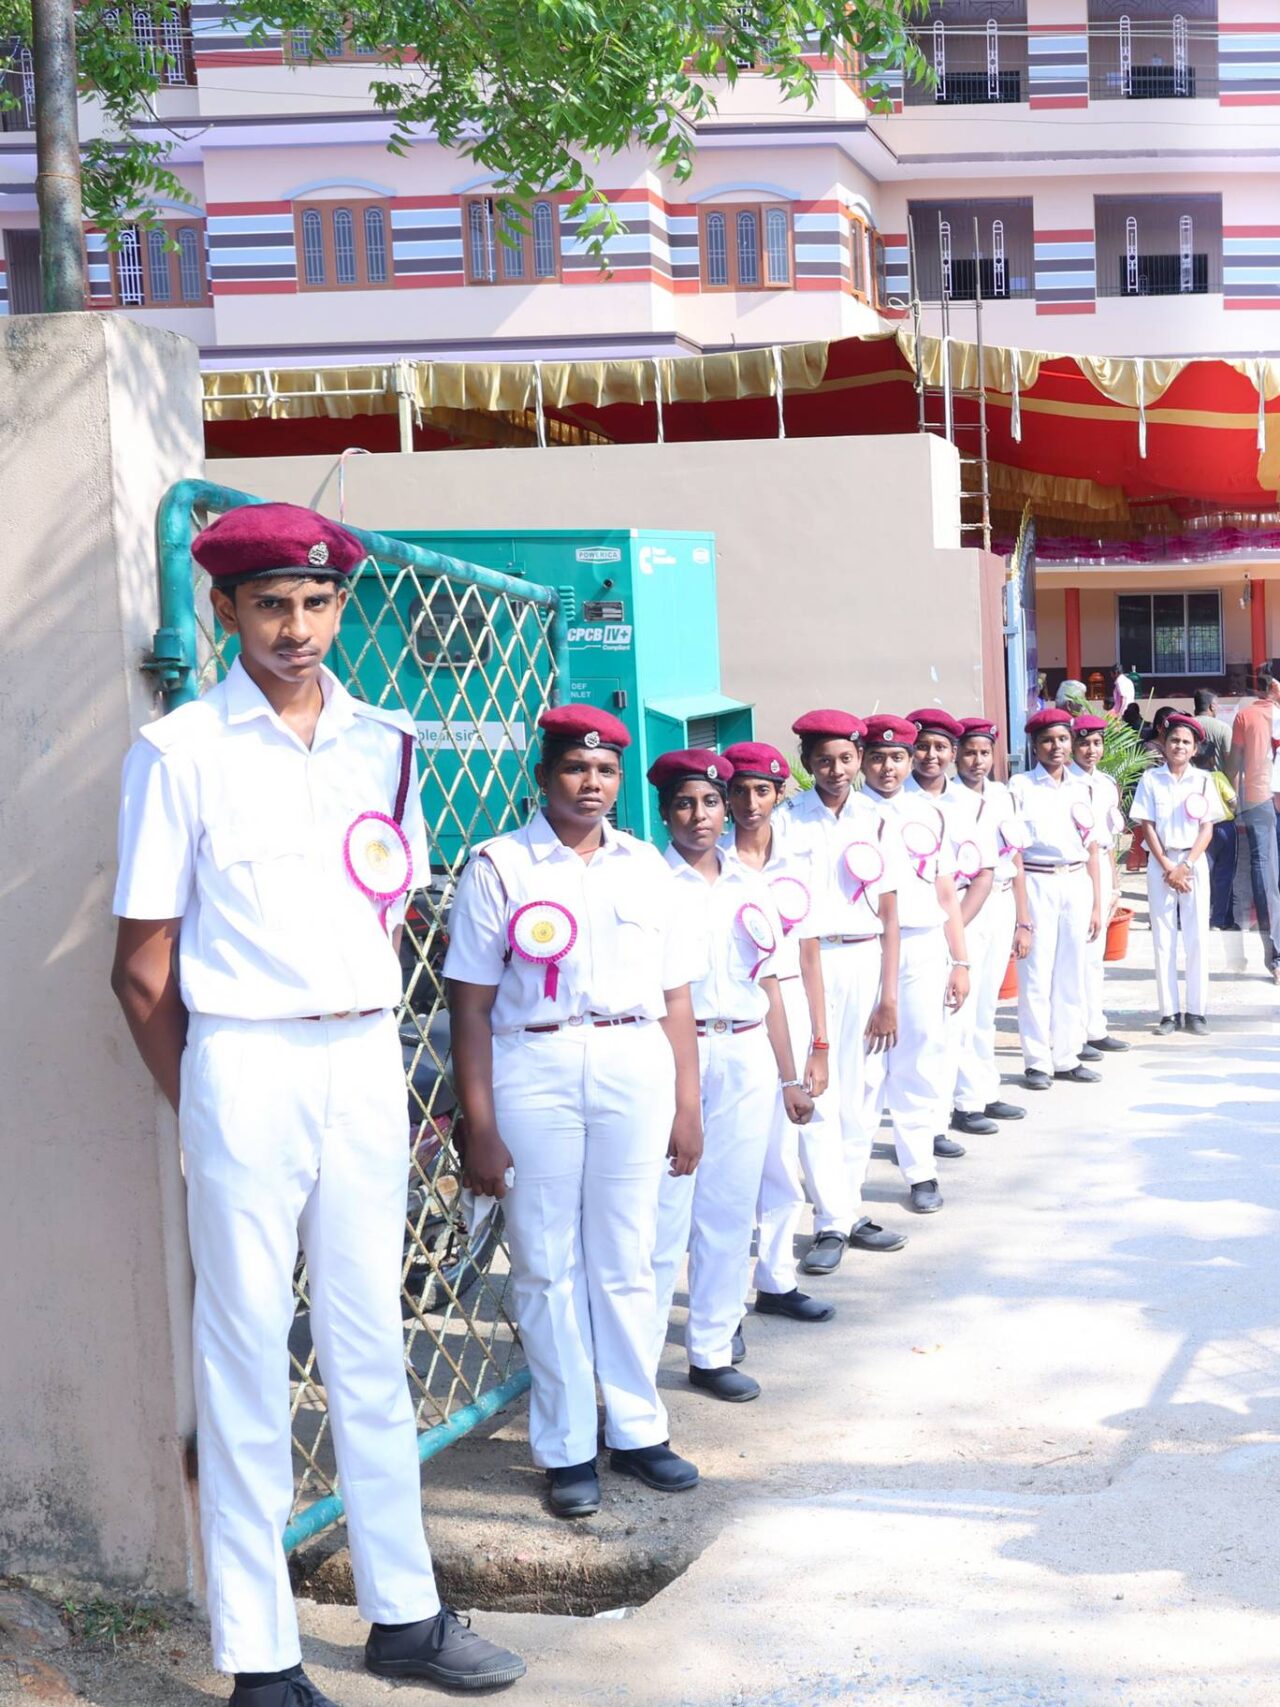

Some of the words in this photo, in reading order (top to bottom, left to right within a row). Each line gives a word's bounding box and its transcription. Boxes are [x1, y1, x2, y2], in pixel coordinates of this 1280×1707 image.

[567, 628, 603, 642] CPCB
[606, 628, 629, 641] IV+
[571, 682, 588, 690] DEF
